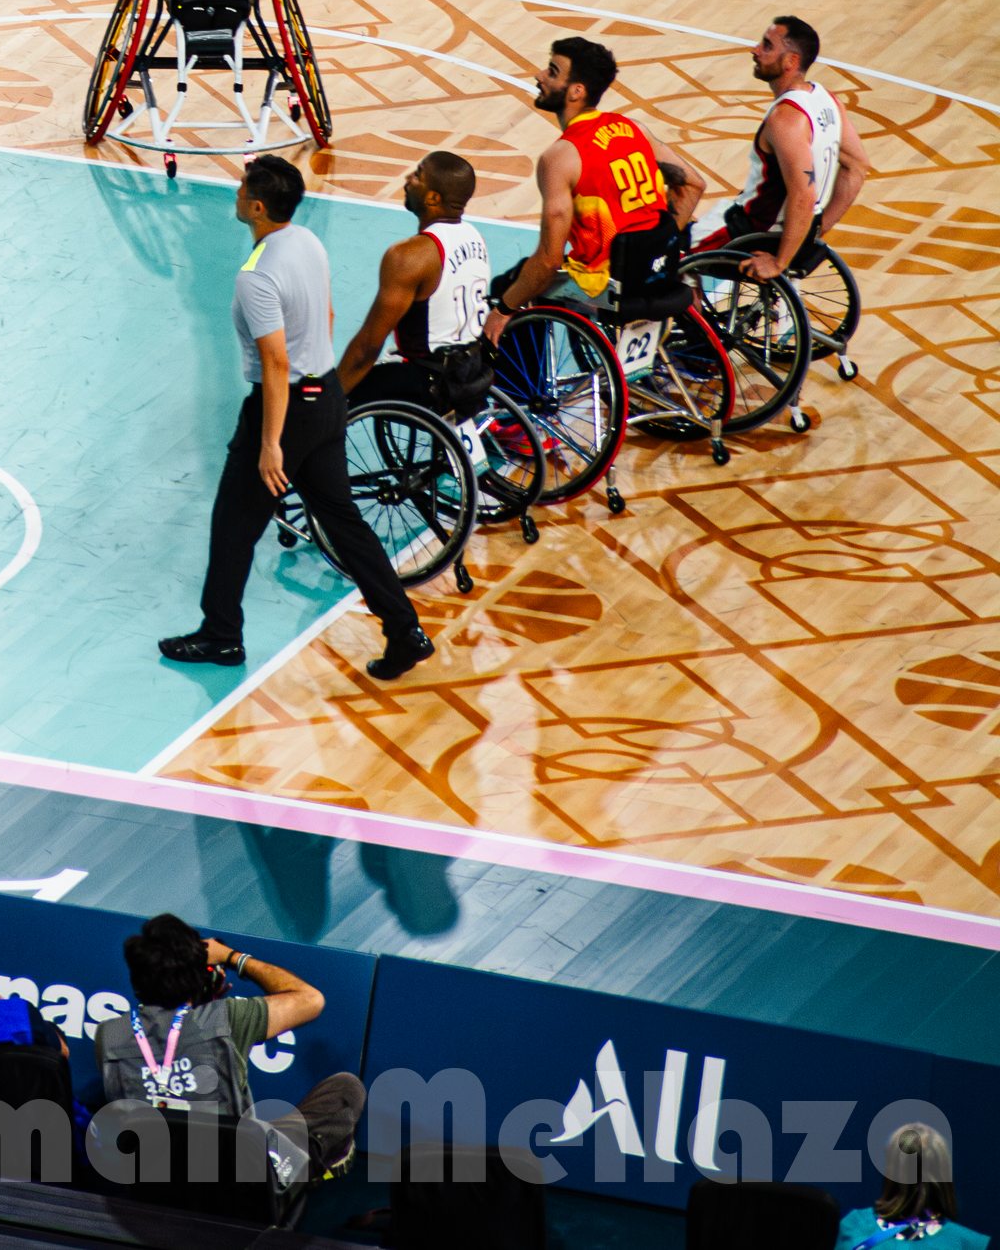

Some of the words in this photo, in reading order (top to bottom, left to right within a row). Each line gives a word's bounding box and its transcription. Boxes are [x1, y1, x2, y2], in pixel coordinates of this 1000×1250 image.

[592, 121, 635, 151] LORENZO
[609, 151, 657, 214] 22
[624, 332, 650, 364] 22
[141, 1057, 192, 1081] PTO
